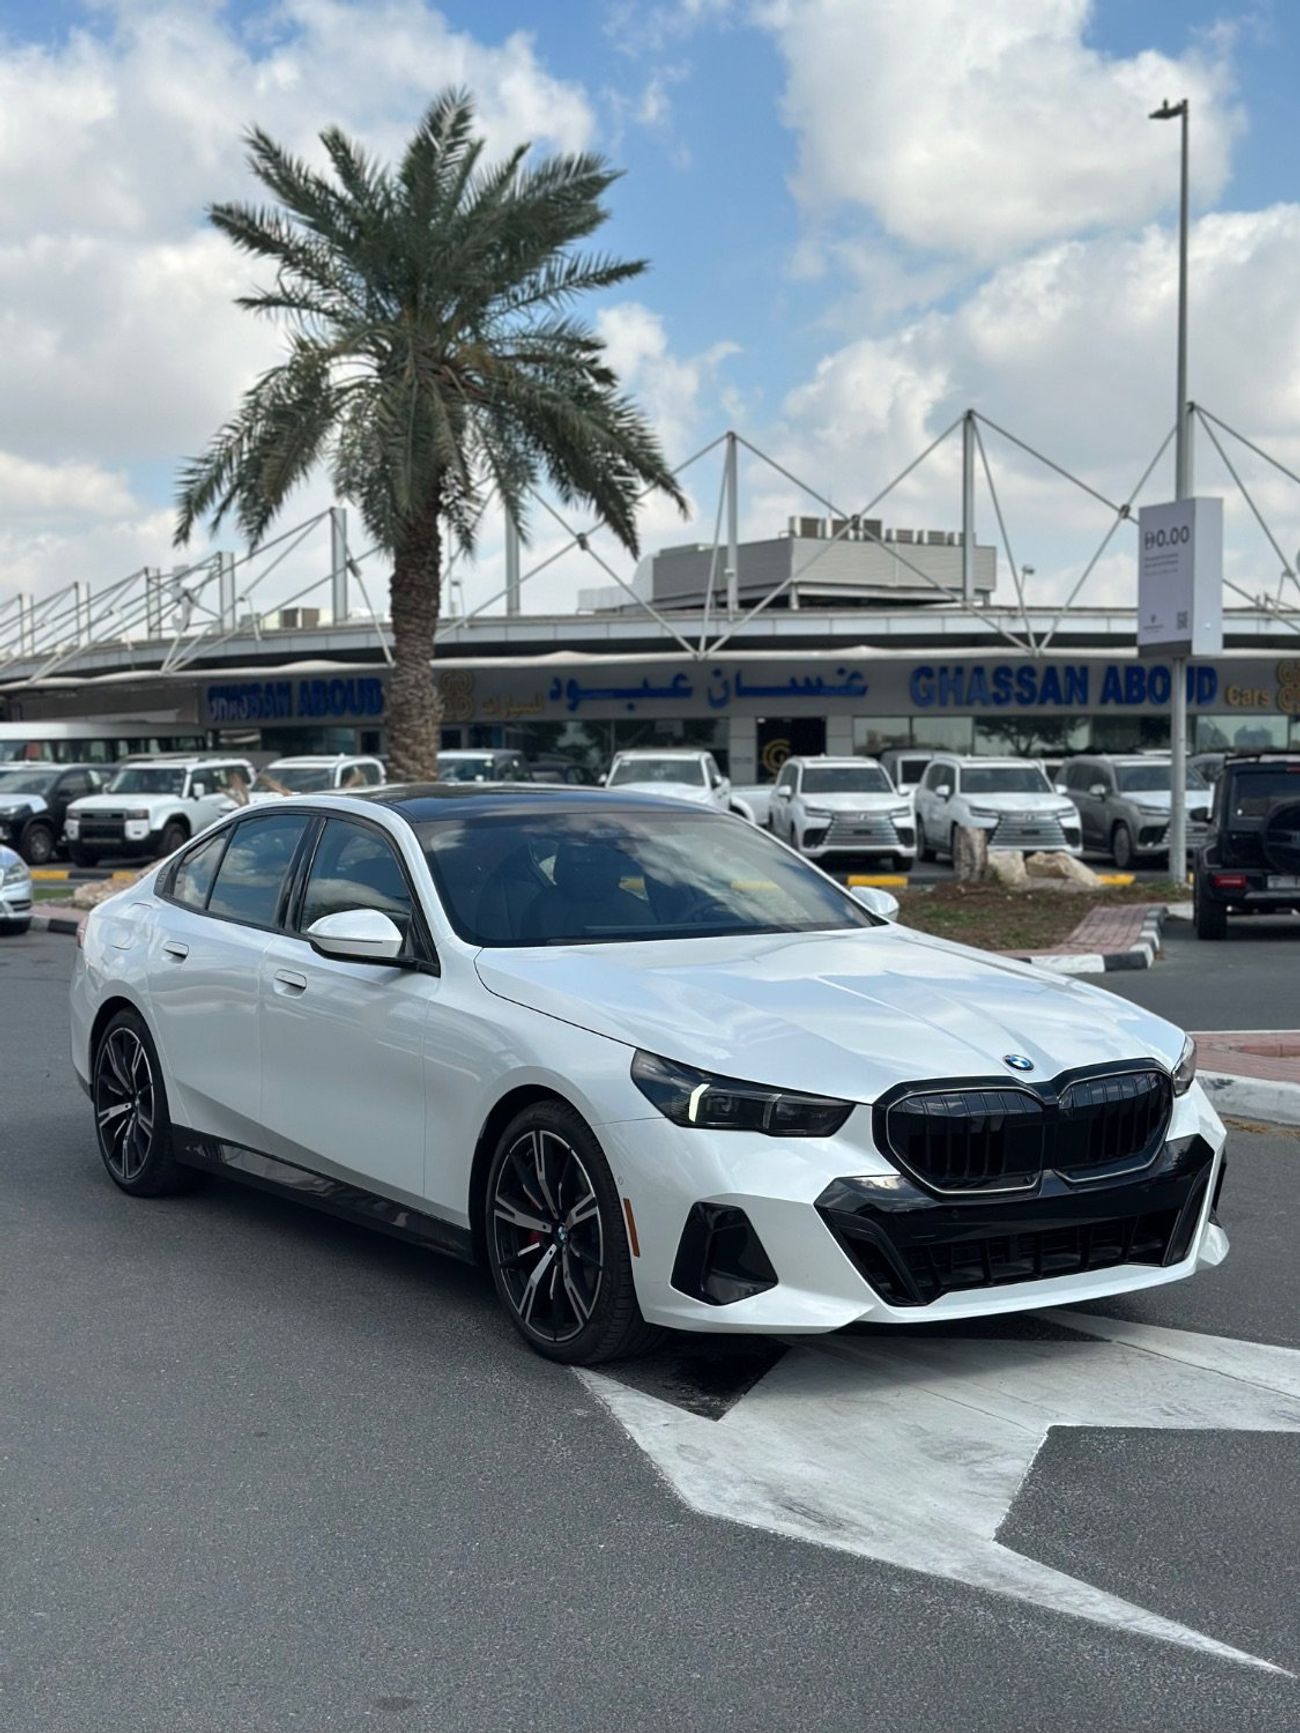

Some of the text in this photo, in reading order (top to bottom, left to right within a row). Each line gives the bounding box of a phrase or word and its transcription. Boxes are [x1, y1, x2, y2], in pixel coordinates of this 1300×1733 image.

[549, 673, 693, 712] عبود
[911, 664, 1089, 708] GHASSAN
[1225, 685, 1271, 707] Cars
